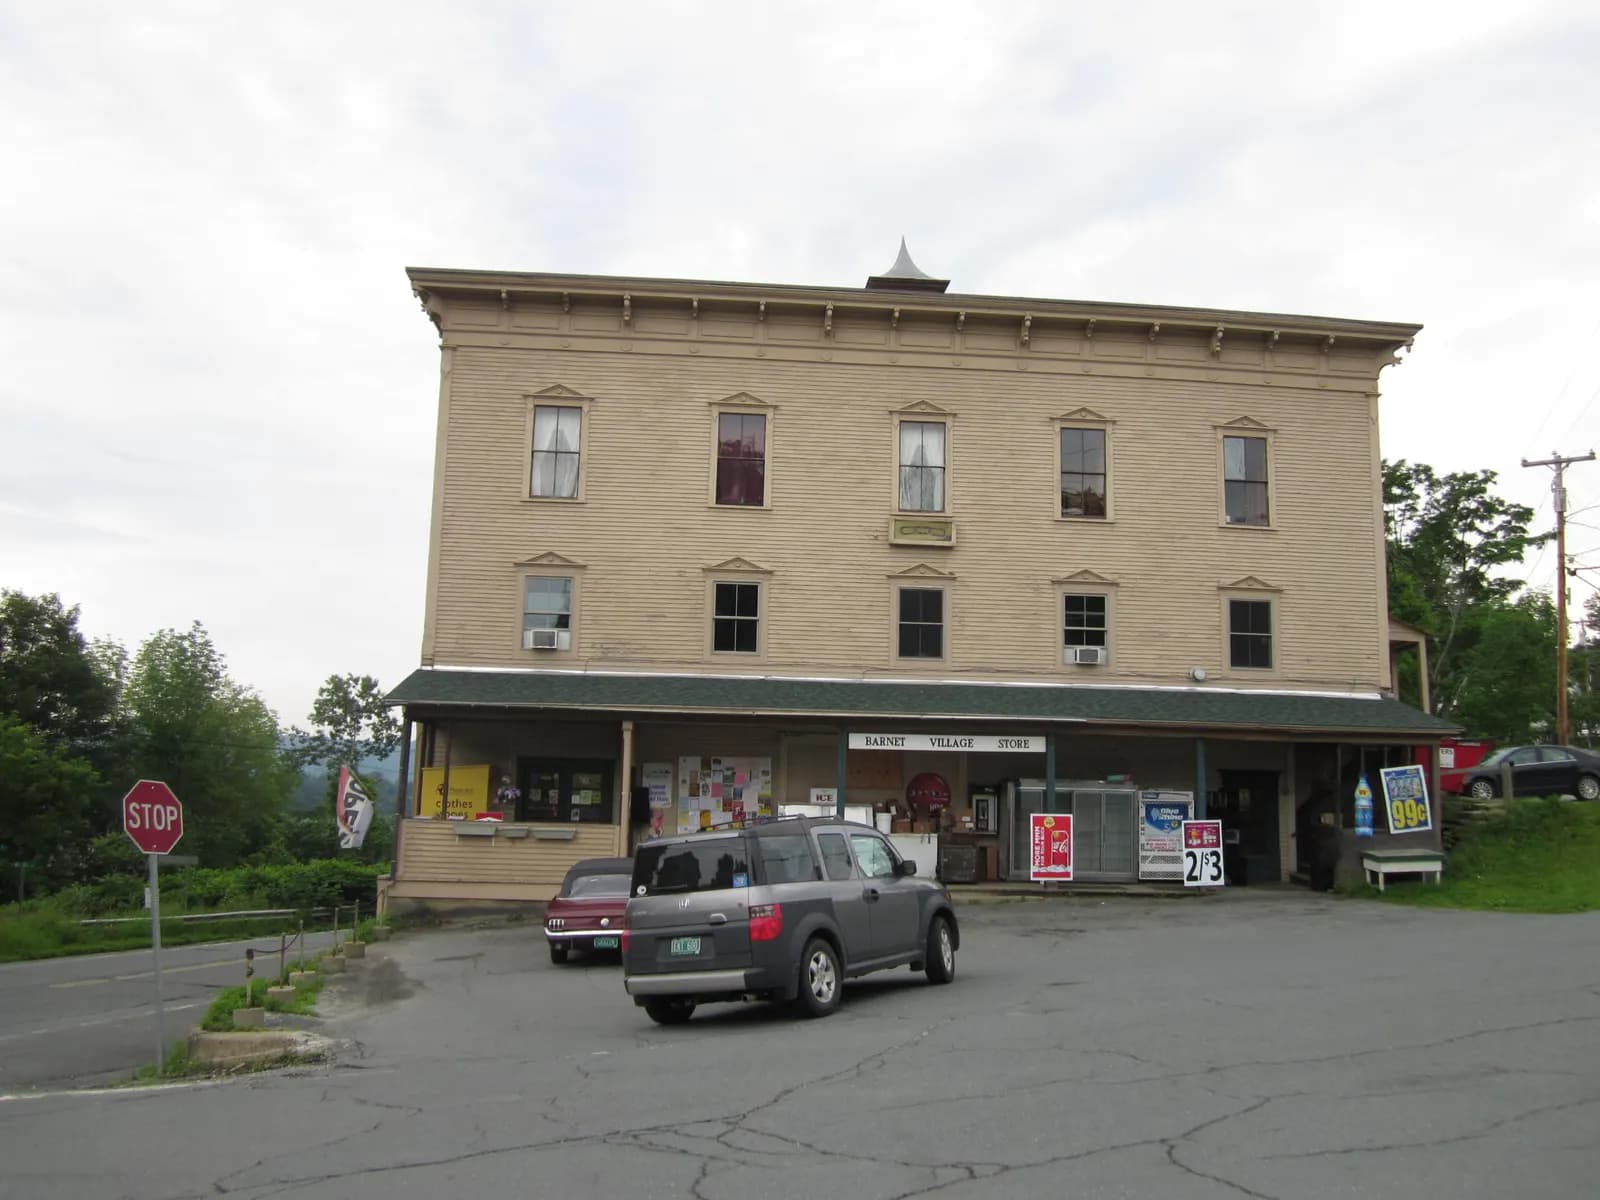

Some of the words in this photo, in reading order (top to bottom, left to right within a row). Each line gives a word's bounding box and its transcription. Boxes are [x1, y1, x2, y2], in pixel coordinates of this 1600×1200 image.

[865, 737, 906, 747] BARNET
[930, 738, 974, 748] VILLAGE
[997, 739, 1030, 749] STORE
[435, 799, 473, 808] cothes
[816, 794, 833, 802] ICE
[128, 802, 178, 831] STOP
[1185, 850, 1222, 882] 2/$3
